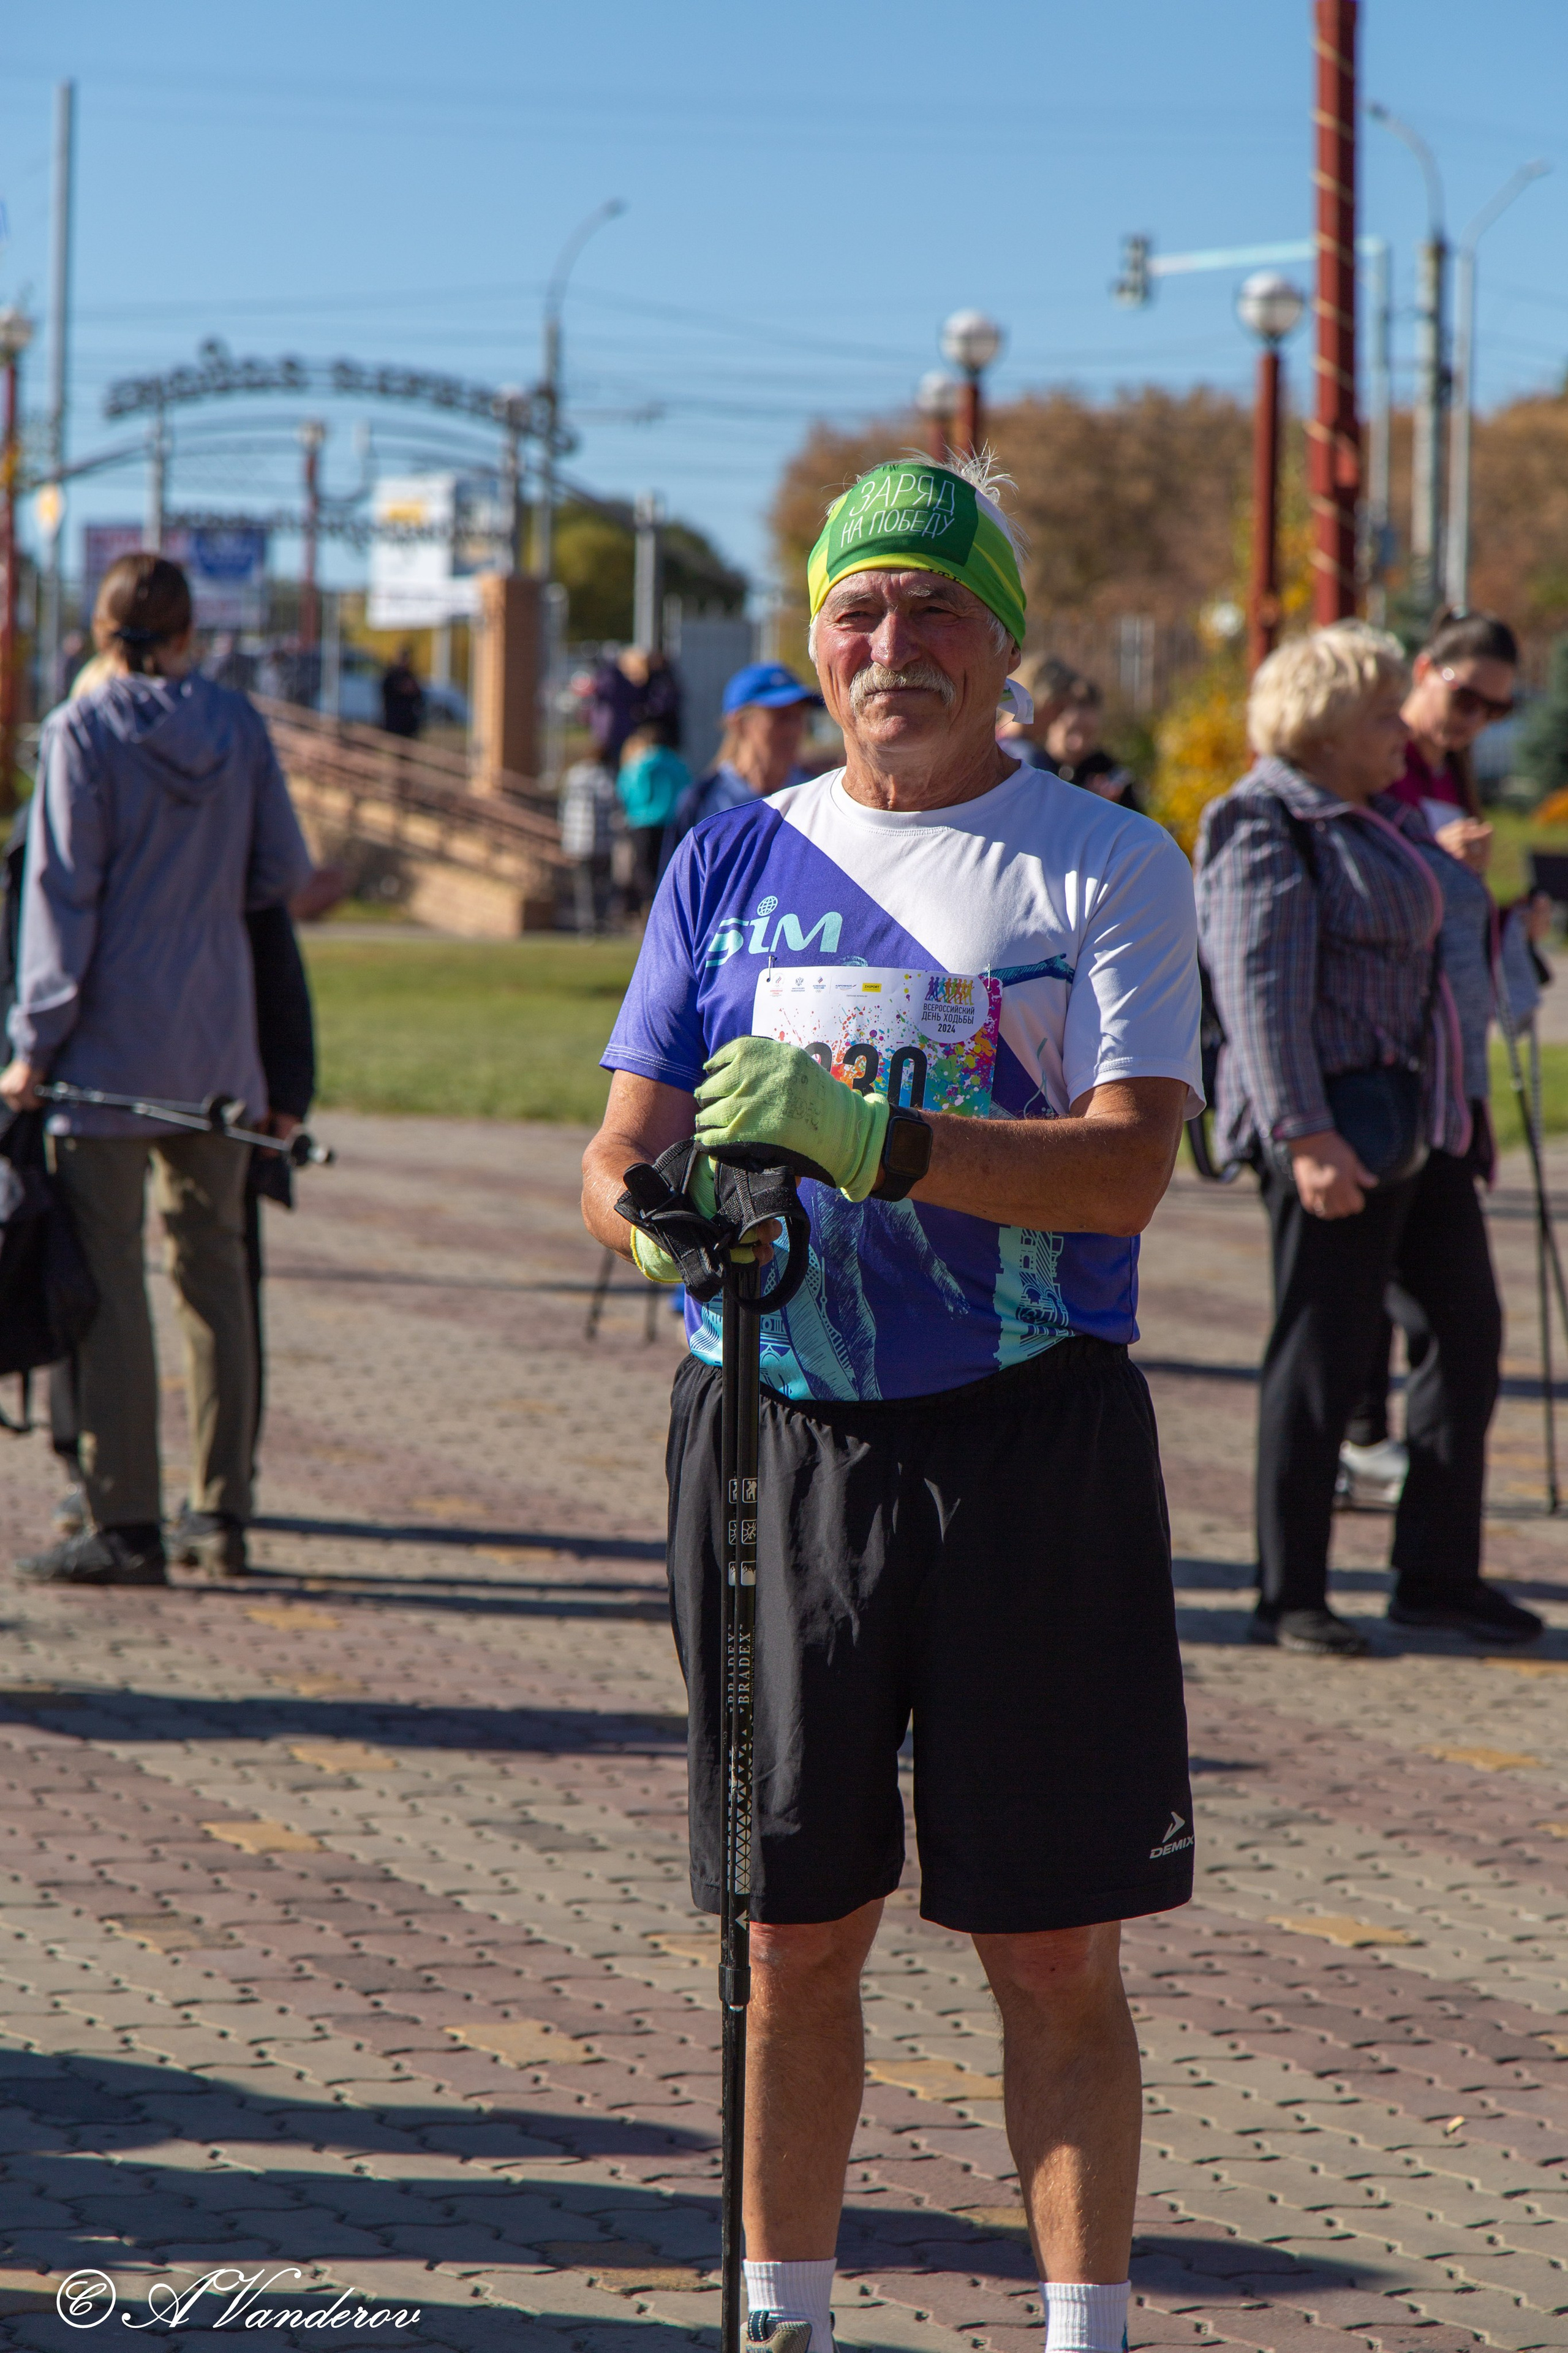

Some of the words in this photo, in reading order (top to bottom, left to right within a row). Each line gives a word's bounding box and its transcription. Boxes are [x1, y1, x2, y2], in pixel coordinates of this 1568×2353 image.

[849, 474, 955, 516] ЗАРЯД
[840, 516, 862, 548] НА
[869, 509, 955, 539] ПОБЕДУ
[921, 1011, 941, 1021] ДЕНЬ
[943, 1013, 974, 1024] ХОДЬБЫ
[923, 1003, 975, 1015] ВСЕРОССИЙСКИЙ
[938, 1024, 956, 1033] 2024
[738, 1632, 750, 1704] BRADEX
[1150, 1835, 1194, 1859] DEMIX
